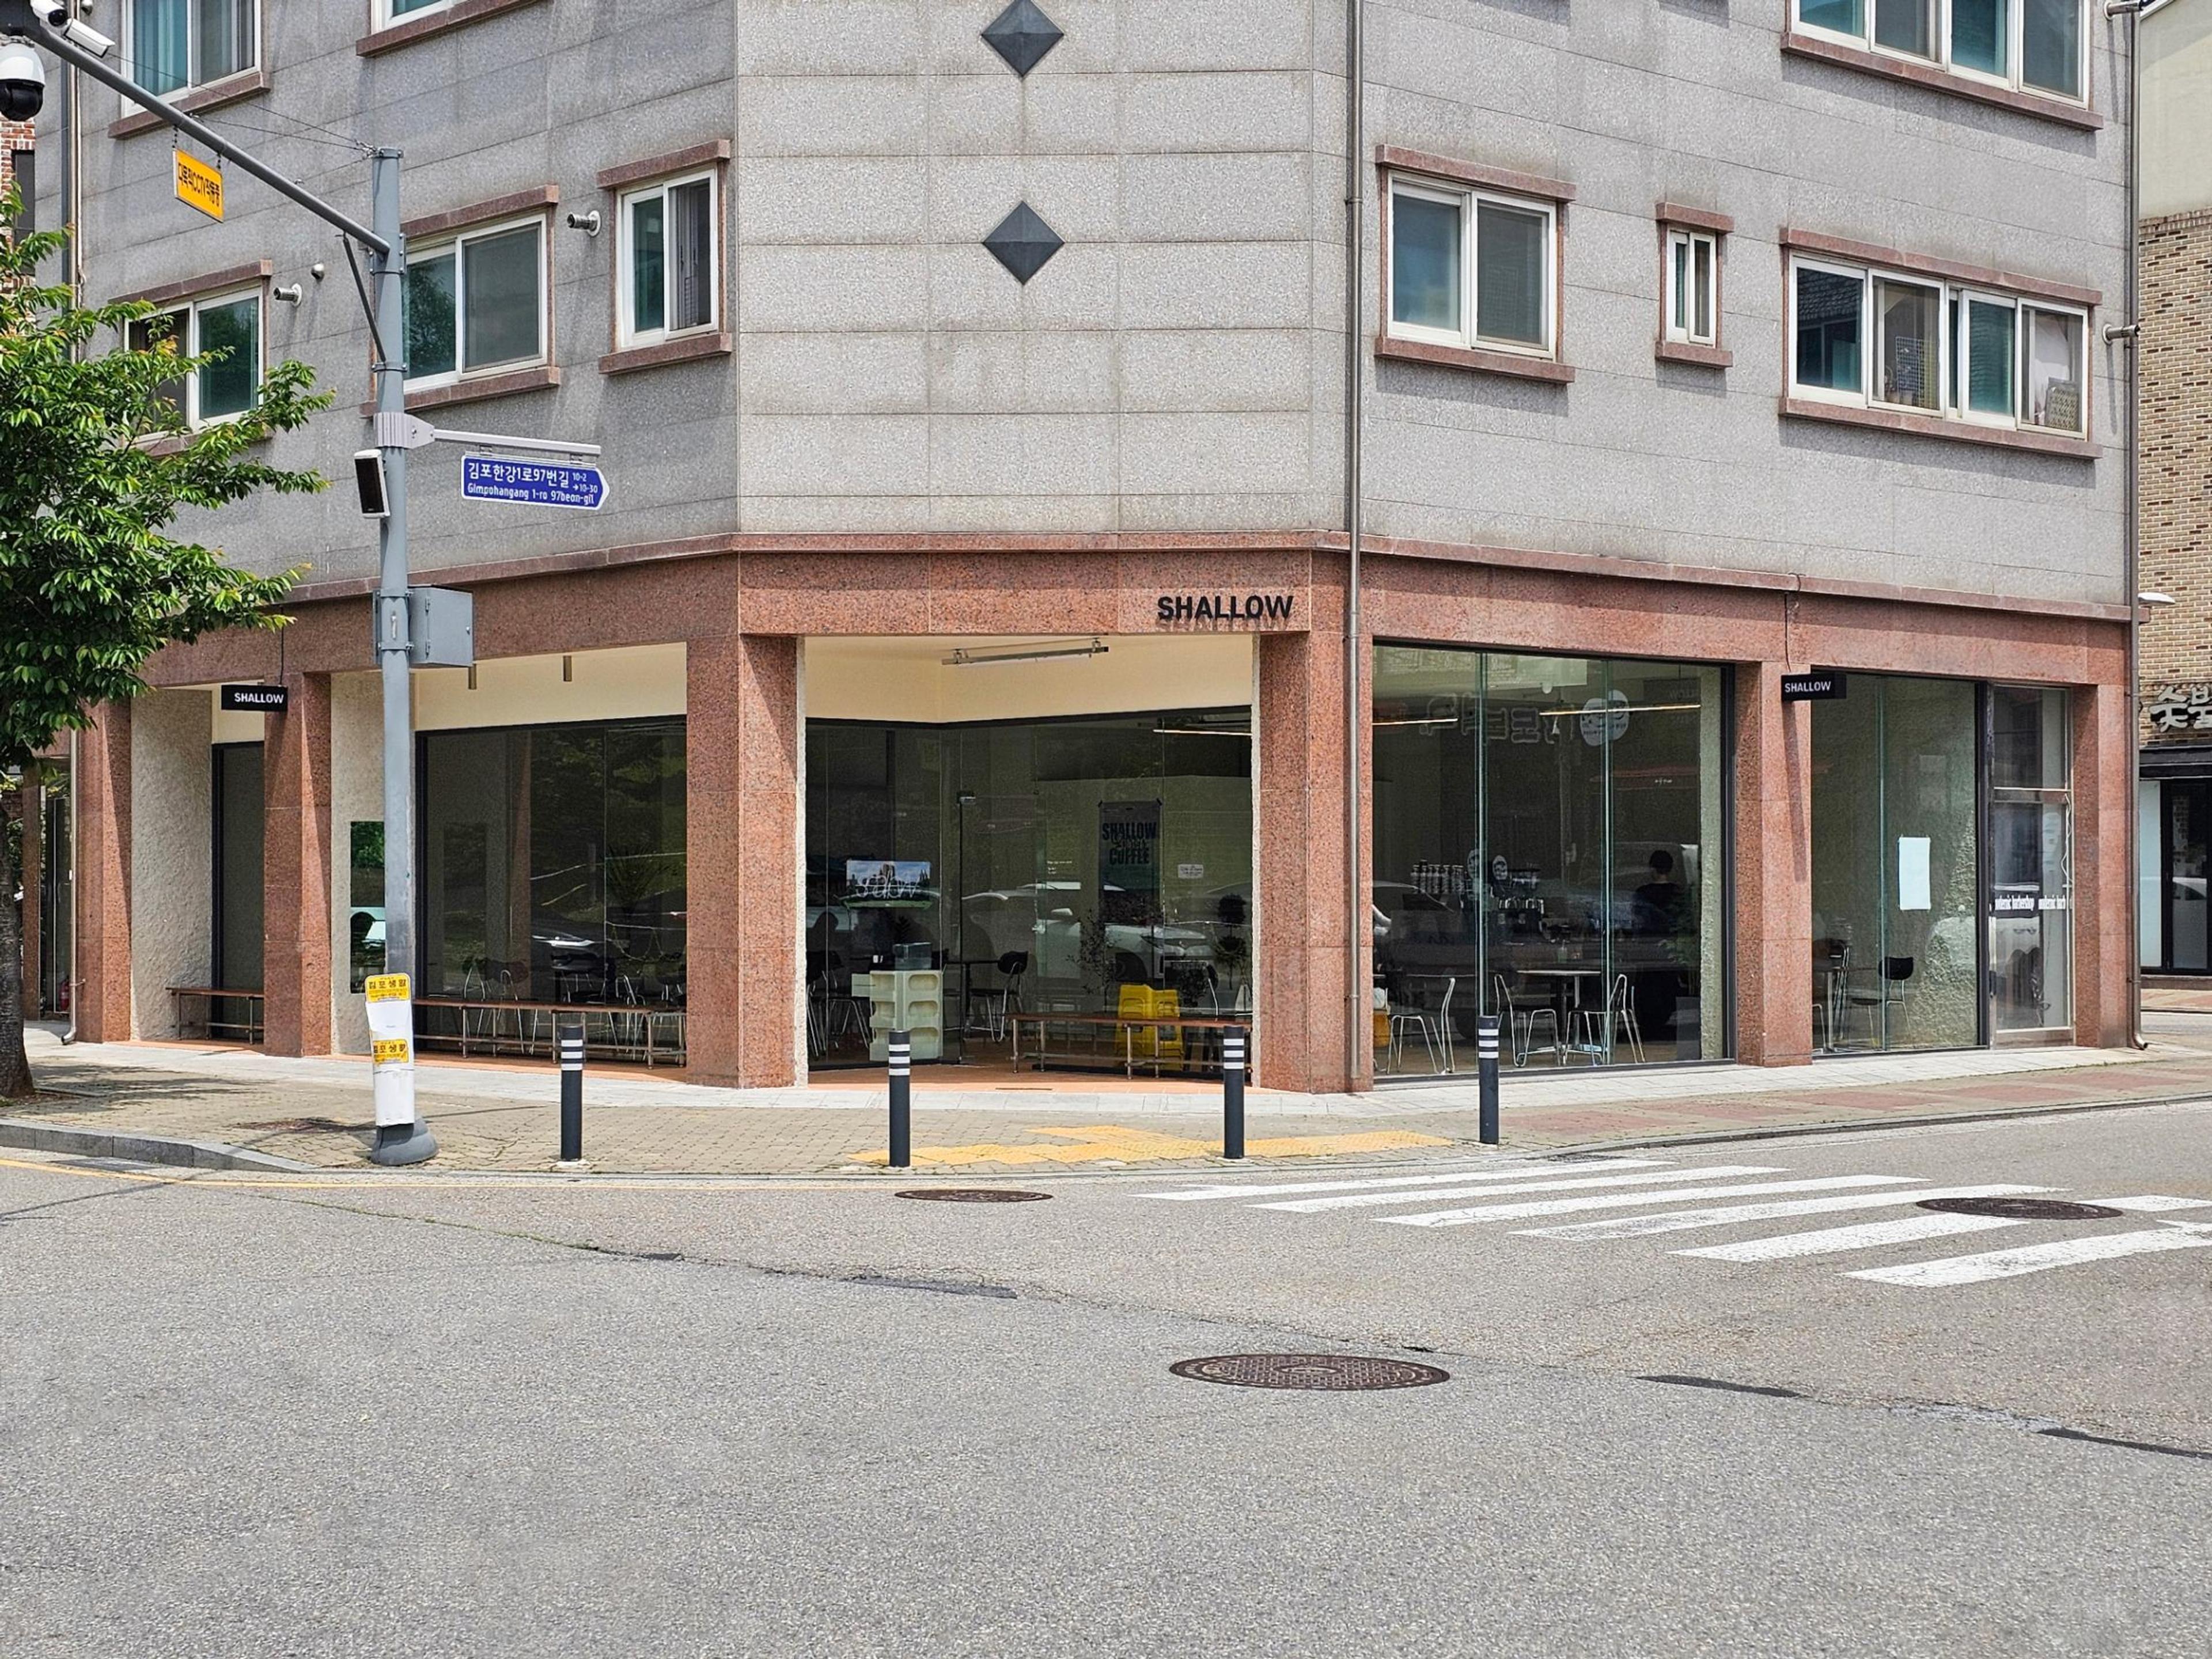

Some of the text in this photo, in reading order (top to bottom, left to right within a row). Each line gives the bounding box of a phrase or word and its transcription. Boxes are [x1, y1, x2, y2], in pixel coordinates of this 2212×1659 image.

[468, 463, 569, 488] 김포한강1로97번길
[467, 483, 594, 505] Gimpohangang 1-ro 97beon-gil
[1157, 595, 1294, 620] SHALLOW
[1785, 681, 1831, 692] SHALLOW
[234, 692, 284, 703] SHALLOW
[1102, 822, 1157, 840] SHALLOW
